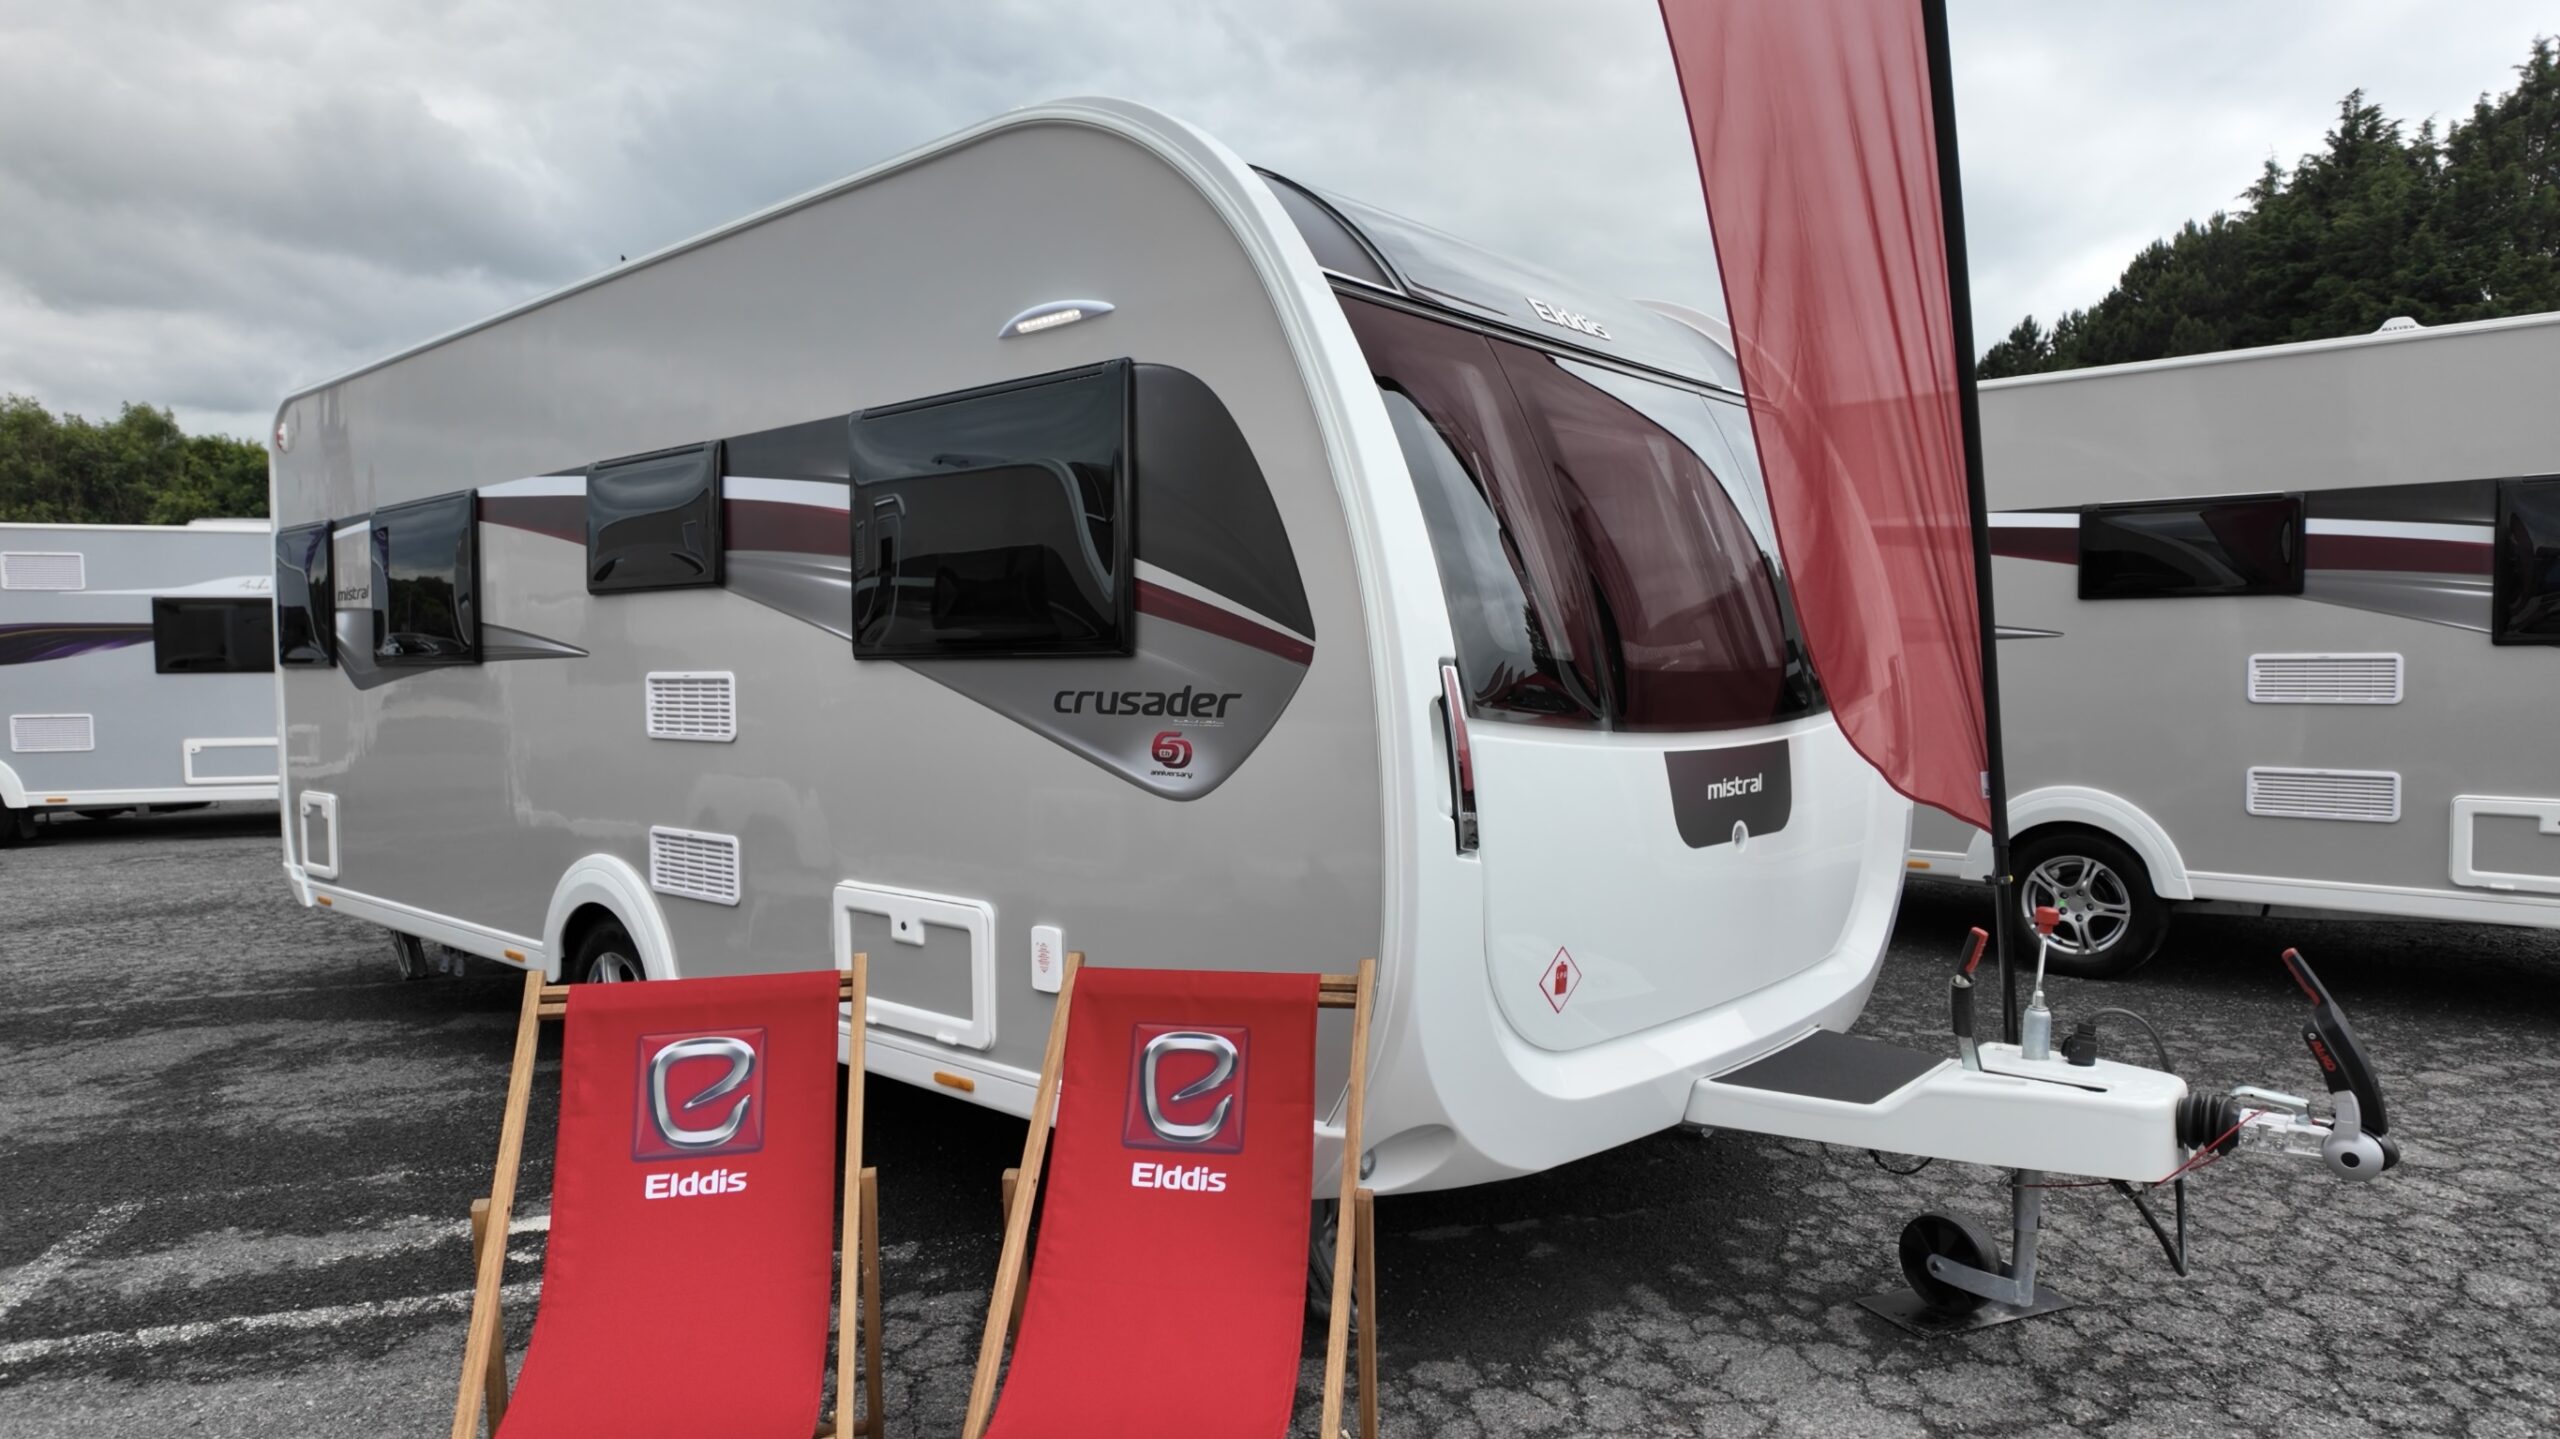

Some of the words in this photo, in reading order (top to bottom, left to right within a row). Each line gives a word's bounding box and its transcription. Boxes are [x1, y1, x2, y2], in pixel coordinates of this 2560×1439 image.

[1525, 296, 1611, 341] Elddis
[337, 584, 370, 602] mistral
[1054, 685, 1243, 718] crusader
[1150, 768, 1194, 779] anniversary
[1707, 772, 1763, 801] mistral
[645, 1168, 748, 1200] Elddis
[1131, 1162, 1227, 1192] Elddis
